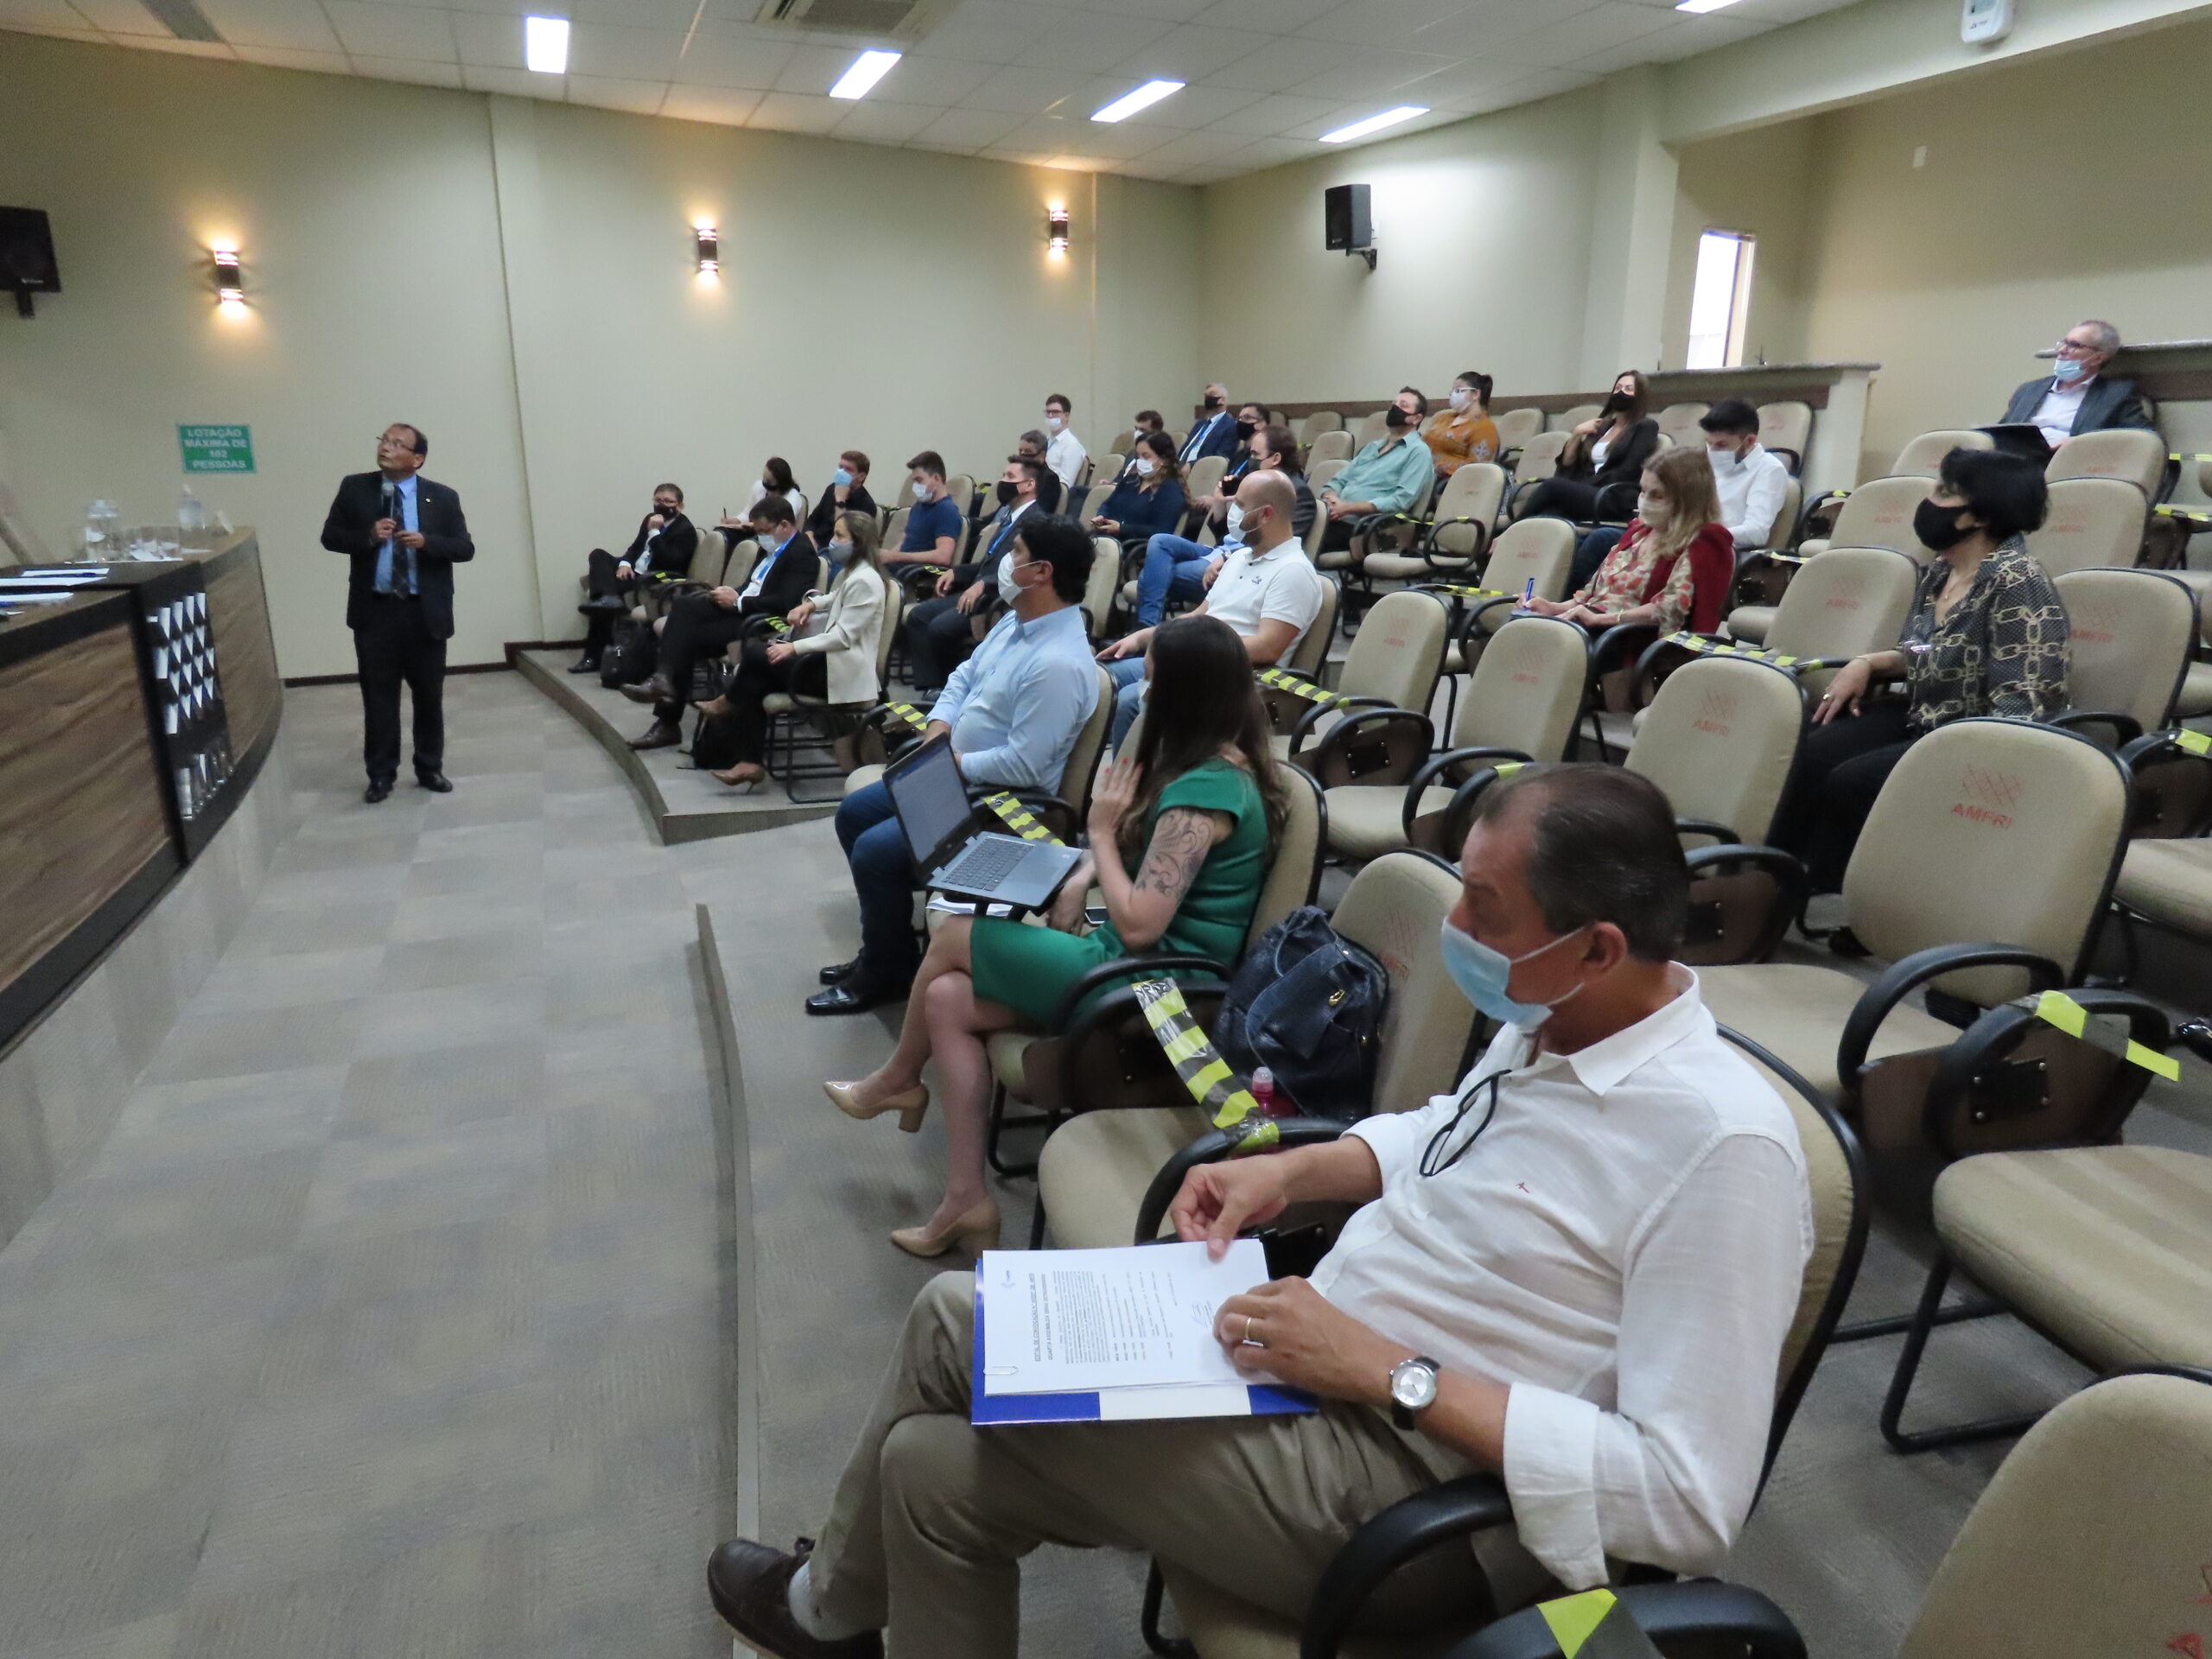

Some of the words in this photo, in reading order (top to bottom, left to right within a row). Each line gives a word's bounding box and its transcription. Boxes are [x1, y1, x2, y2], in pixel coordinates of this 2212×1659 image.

[188, 428, 242, 438] LOTAÇÃO
[184, 437, 230, 448] MÁXIMA
[232, 439, 248, 448] DE
[193, 460, 246, 469] PESSOAS
[1951, 803, 2015, 830] AMFRI
